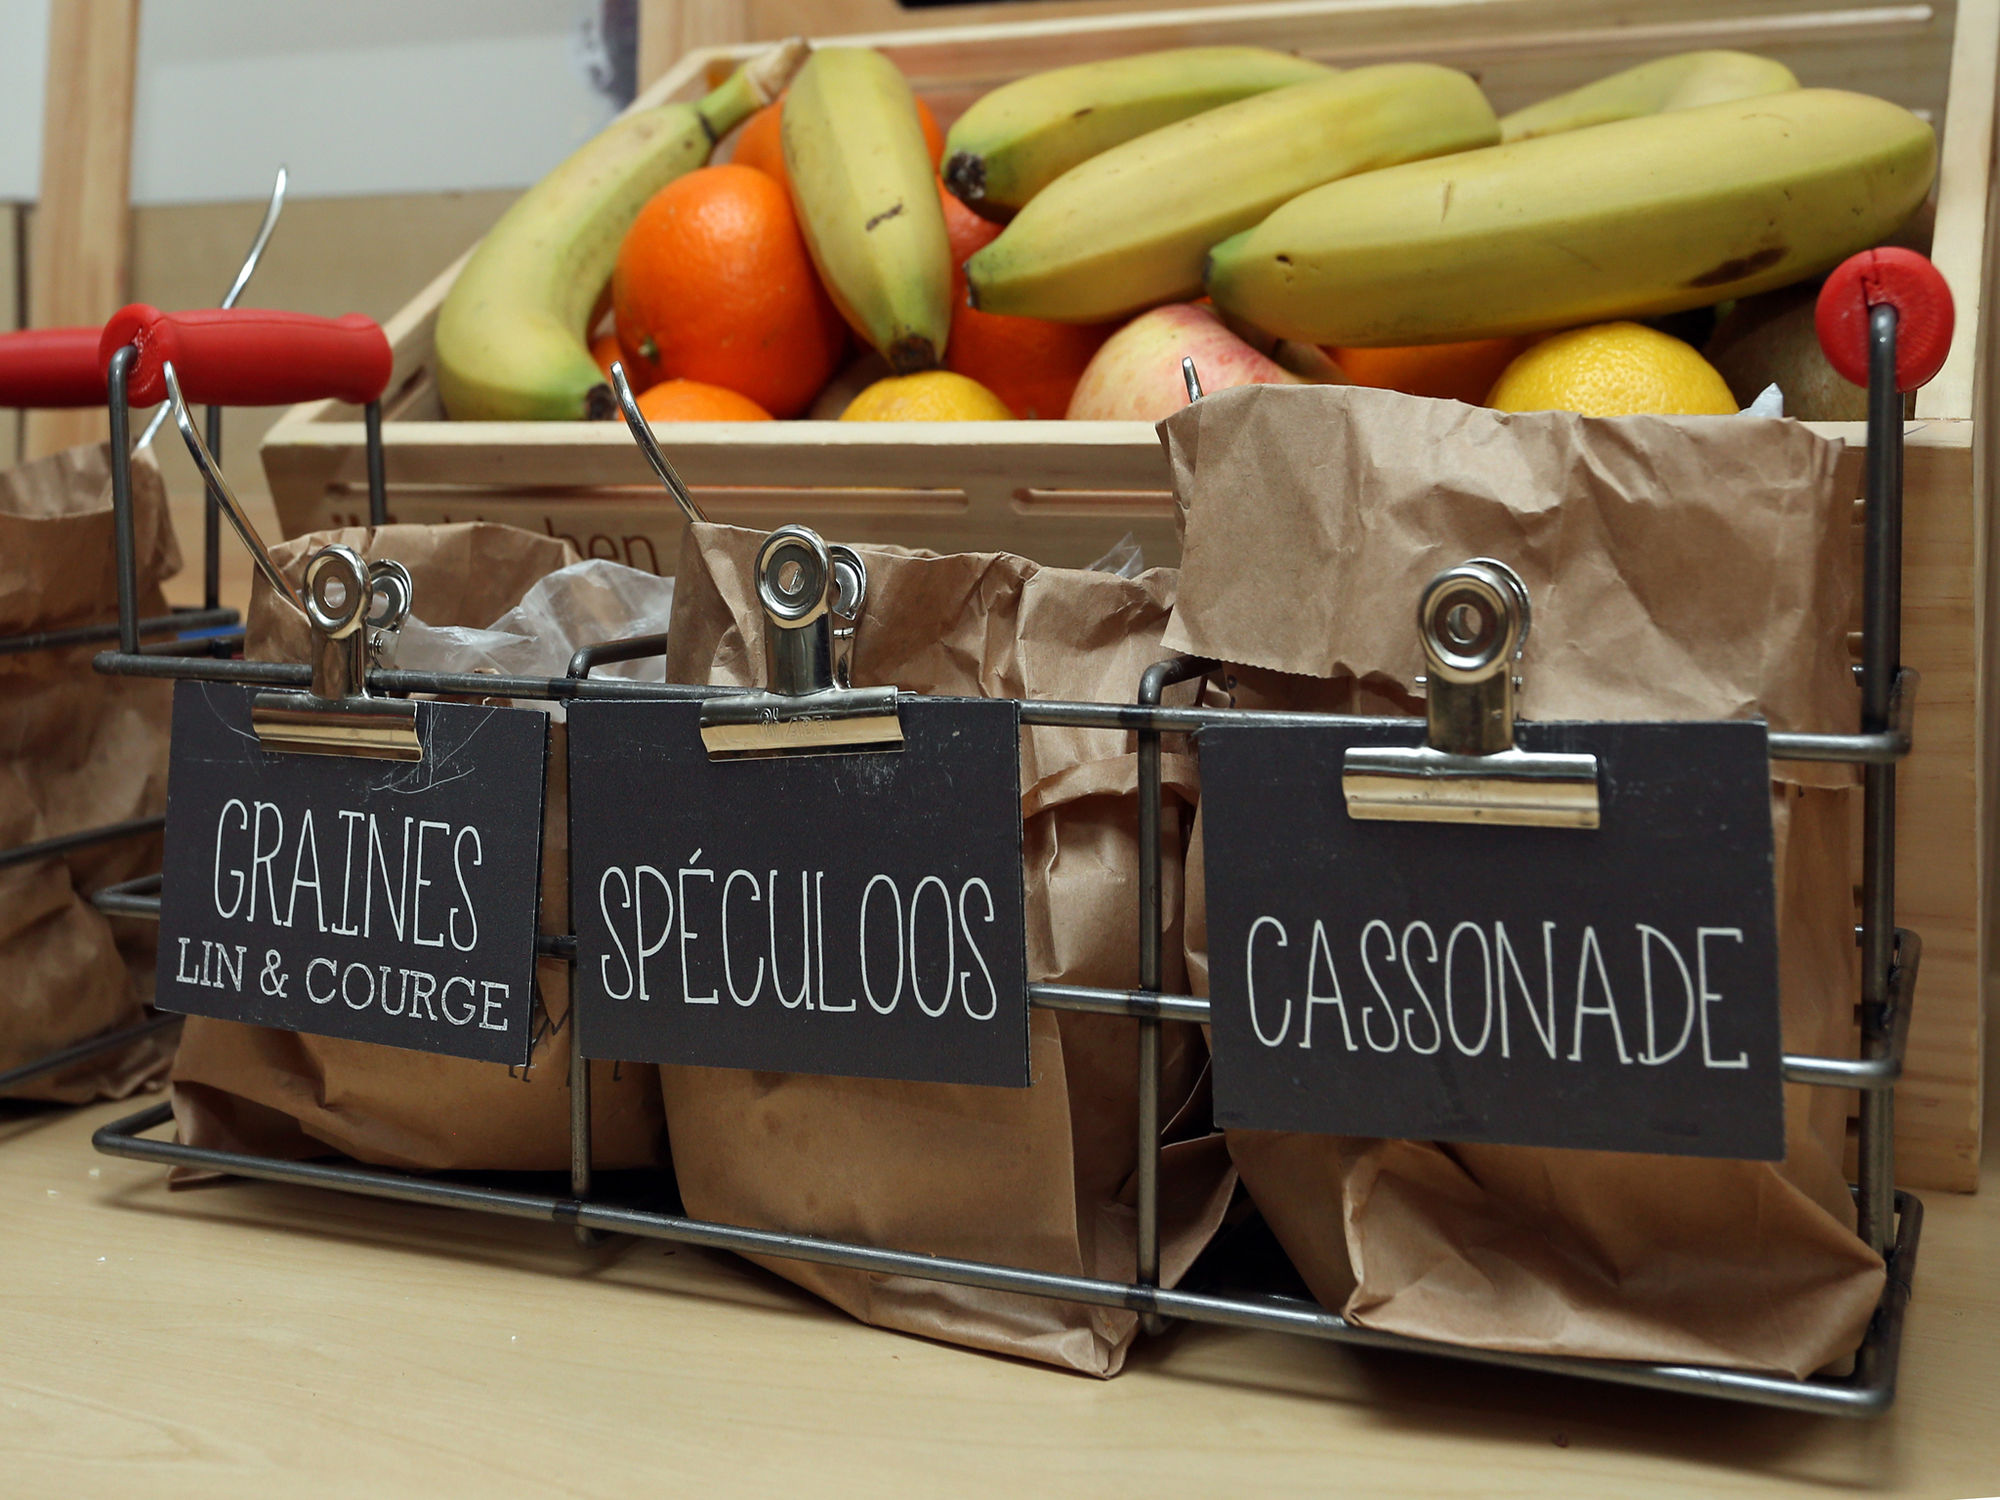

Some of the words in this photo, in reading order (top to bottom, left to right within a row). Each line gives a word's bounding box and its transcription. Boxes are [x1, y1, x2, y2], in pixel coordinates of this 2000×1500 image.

[214, 798, 482, 952] GRAINES
[599, 847, 997, 1021] SPÉCULOOS
[176, 937, 248, 992] LIN
[259, 949, 289, 999] &
[305, 957, 511, 1031] COURGE
[1247, 916, 1748, 1069] CASSONADE
